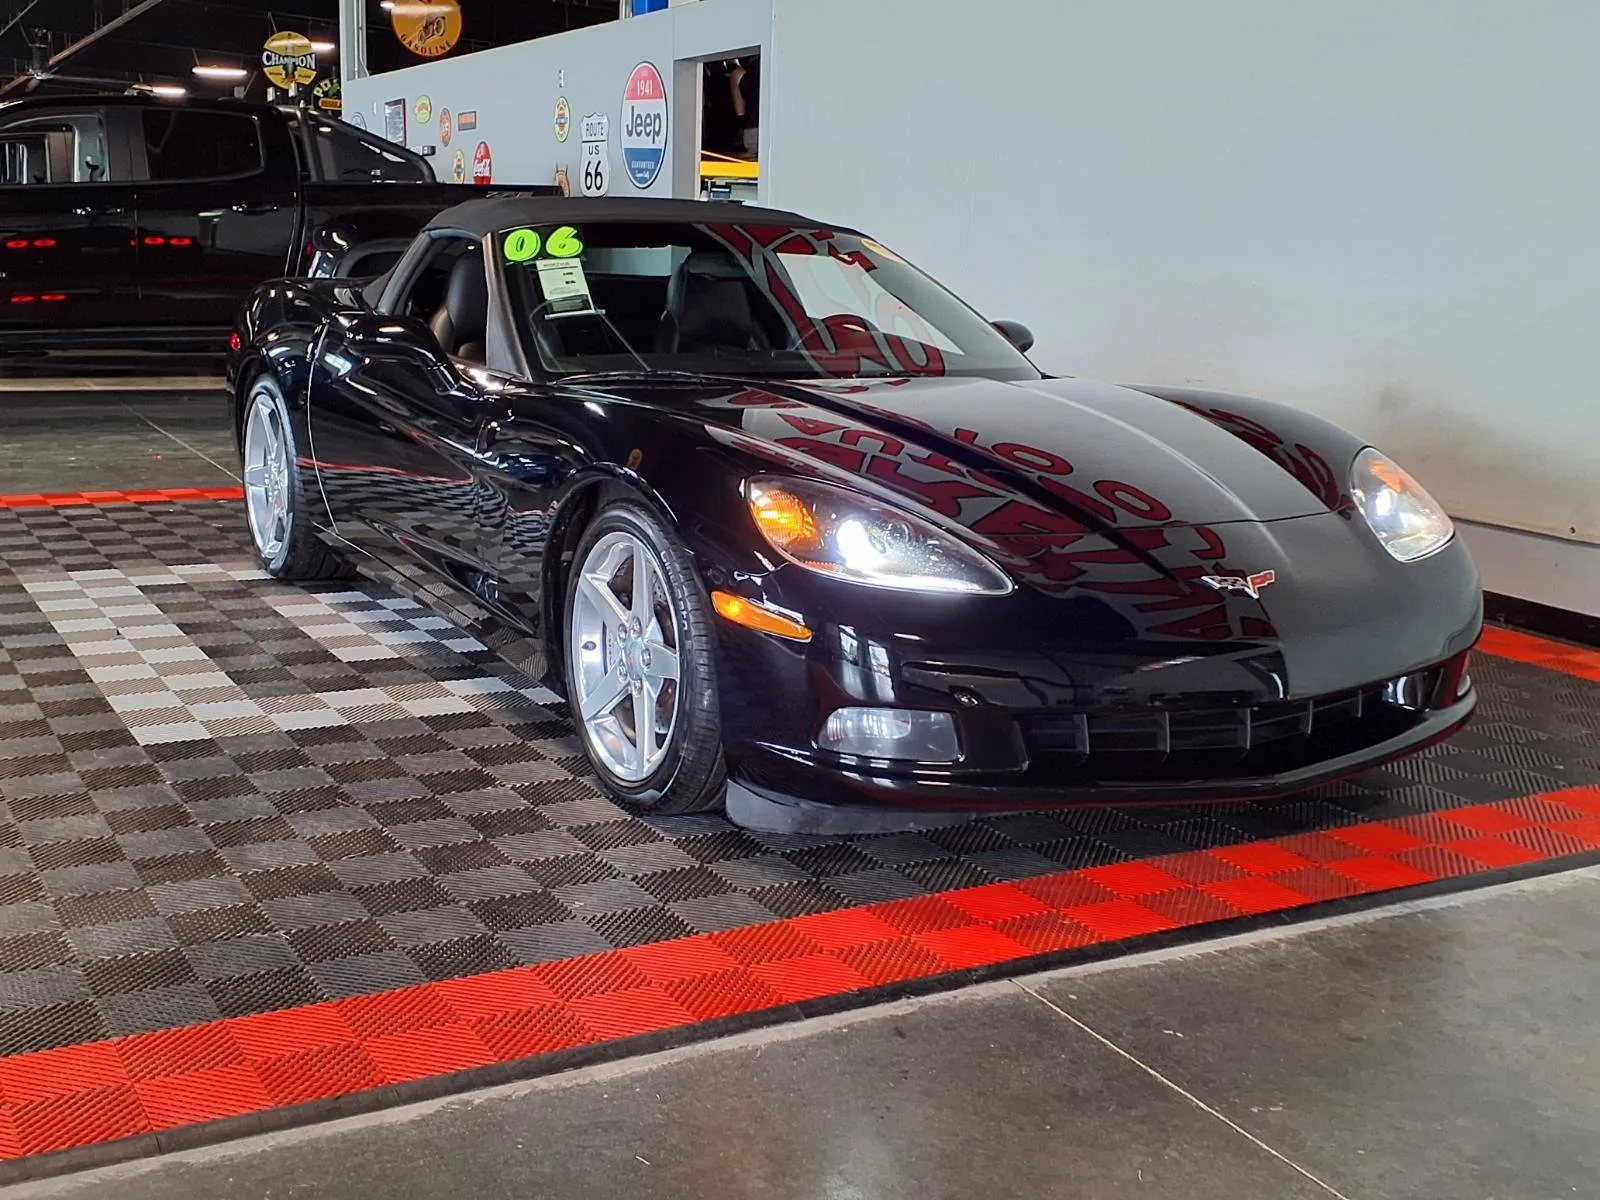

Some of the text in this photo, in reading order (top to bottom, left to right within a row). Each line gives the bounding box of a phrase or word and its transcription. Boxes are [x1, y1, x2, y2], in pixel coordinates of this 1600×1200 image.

[262, 50, 316, 69] CHAMPION
[637, 79, 653, 96] 1941
[585, 122, 604, 137] ROUTE
[626, 105, 661, 144] Jeep
[588, 145, 600, 155] US
[584, 160, 603, 191] 66
[504, 226, 583, 262] 06
